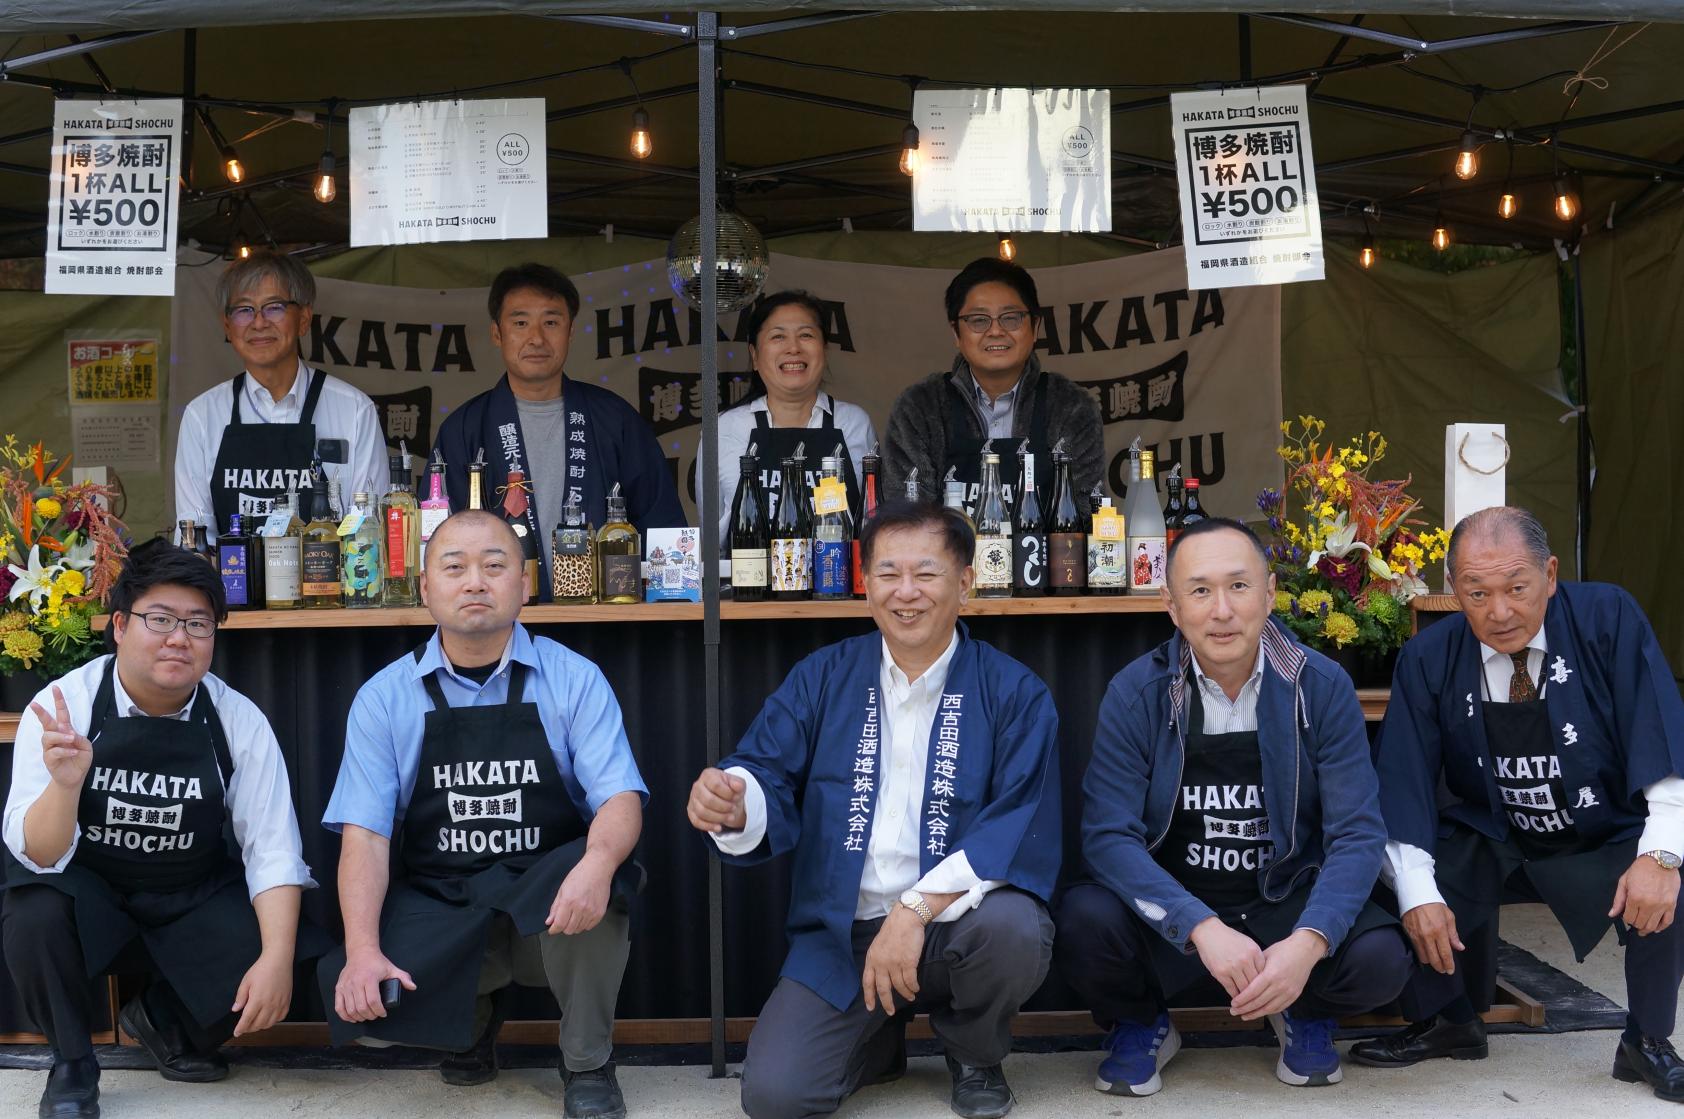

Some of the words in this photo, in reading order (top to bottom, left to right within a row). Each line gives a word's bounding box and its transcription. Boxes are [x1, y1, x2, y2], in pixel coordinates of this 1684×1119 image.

[63, 119, 103, 129] HAKATA
[135, 119, 174, 129] SHOCHU
[1182, 111, 1224, 122] HAKATA
[1257, 105, 1299, 117] SHOCHU
[1069, 133, 1086, 141] ALL
[1193, 130, 1294, 161] 博多焼酎
[69, 143, 165, 168] 博多焼酎
[502, 149, 523, 157] ¥500
[71, 173, 163, 195] 1杯ALL
[1199, 160, 1298, 186] 1杯ALL
[69, 199, 160, 227] ¥500
[1200, 185, 1299, 219] ¥500
[399, 219, 433, 229] HAKATA
[461, 216, 497, 225] SHOCHU
[59, 265, 122, 275] 福岡県酒造組合
[126, 266, 164, 275] 焼酎部会
[1200, 255, 1267, 269] 福岡県酒造組合
[1033, 288, 1225, 356] AKATA
[298, 314, 476, 372] KATA
[1108, 431, 1226, 500] CHU
[224, 468, 313, 489] HAKATA
[1100, 542, 1114, 567] 初潮
[432, 759, 541, 789] HAKATA
[926, 693, 964, 857] 西吉田酒造株式会社
[1493, 755, 1562, 779] KATA
[90, 766, 203, 800] HAKATA
[452, 797, 517, 816] 博多焼酎
[1182, 785, 1265, 810] HAKA
[1503, 789, 1549, 805] 多焼酎
[111, 806, 177, 825] 博多焼酎
[1506, 809, 1575, 833] OCHU
[86, 825, 195, 853] SHOCHU
[437, 826, 541, 854] SHOCHU
[1185, 842, 1275, 872] SHOCH
